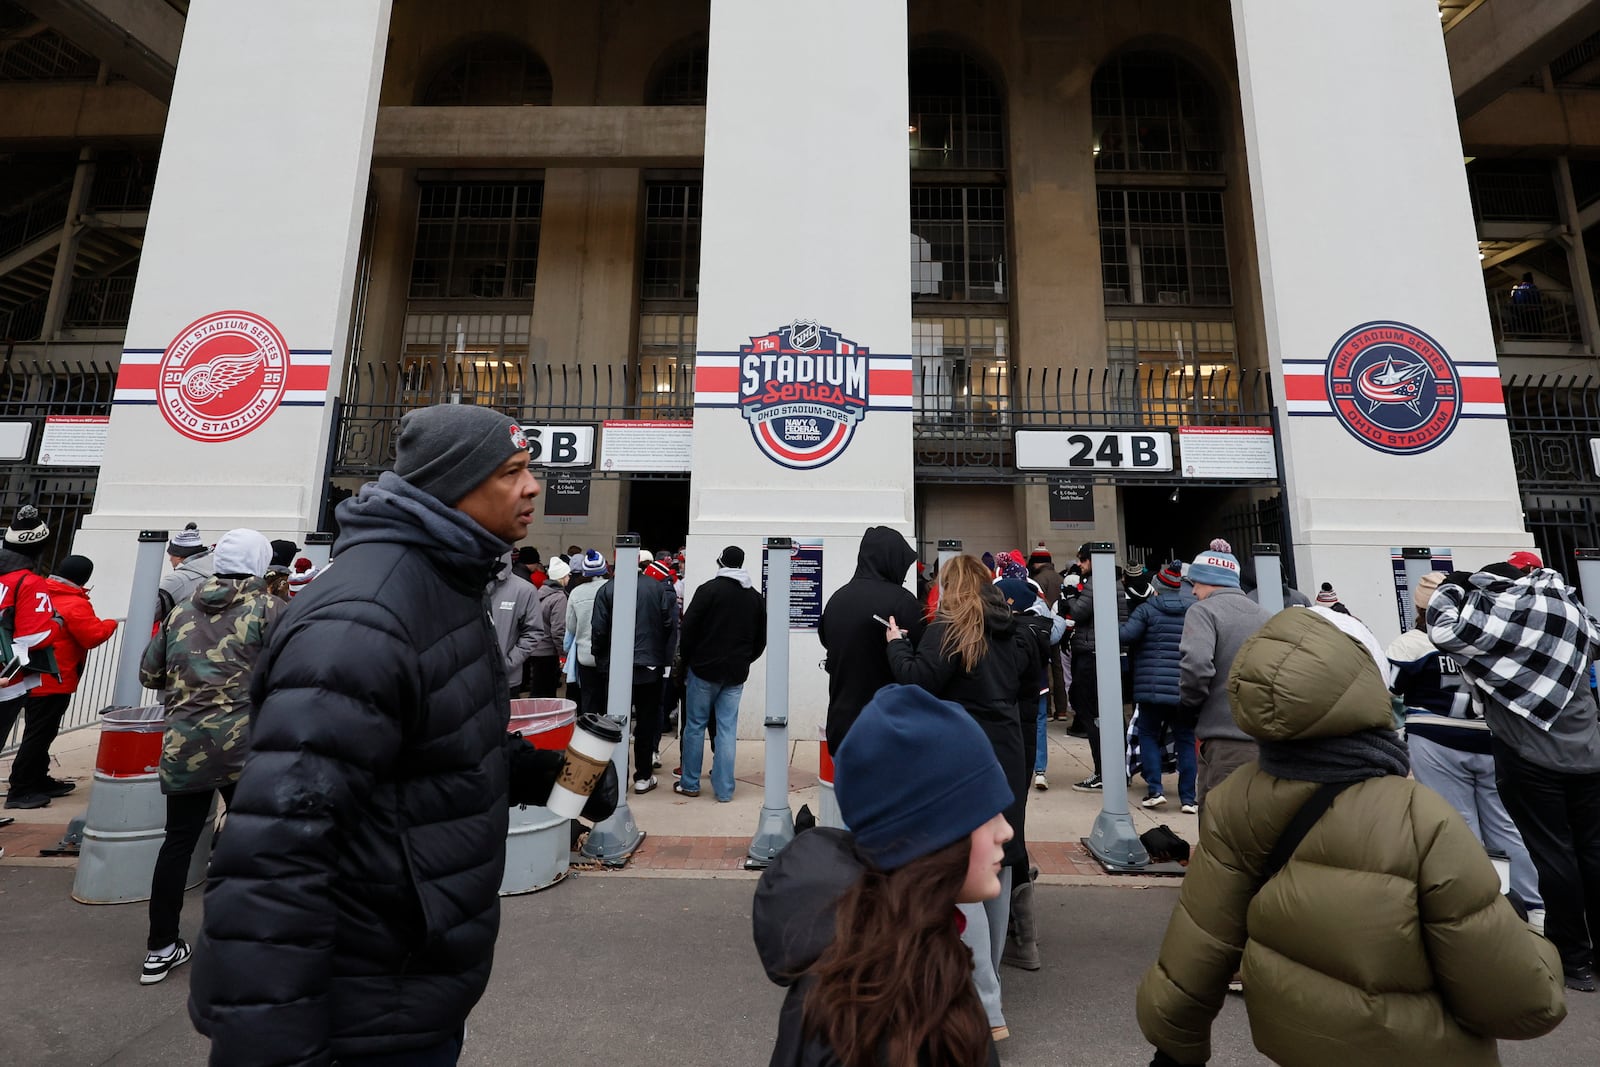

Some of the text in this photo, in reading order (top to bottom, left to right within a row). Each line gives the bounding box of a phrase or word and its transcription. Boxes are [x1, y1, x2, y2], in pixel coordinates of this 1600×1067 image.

[175, 320, 278, 360] NHL STADIUM SERIES
[758, 339, 775, 350] The
[796, 328, 815, 345] NHL
[1337, 331, 1444, 372] NHL STADIUM SERIES
[164, 372, 281, 383] 20 25
[742, 354, 866, 399] STADIUM
[763, 380, 845, 404] Series
[1334, 384, 1454, 395] 20 25
[170, 398, 268, 432] OHIO STADIUM
[757, 405, 848, 423] OHIO STADIUM 2025
[1347, 410, 1449, 445] OHIO STADIUM
